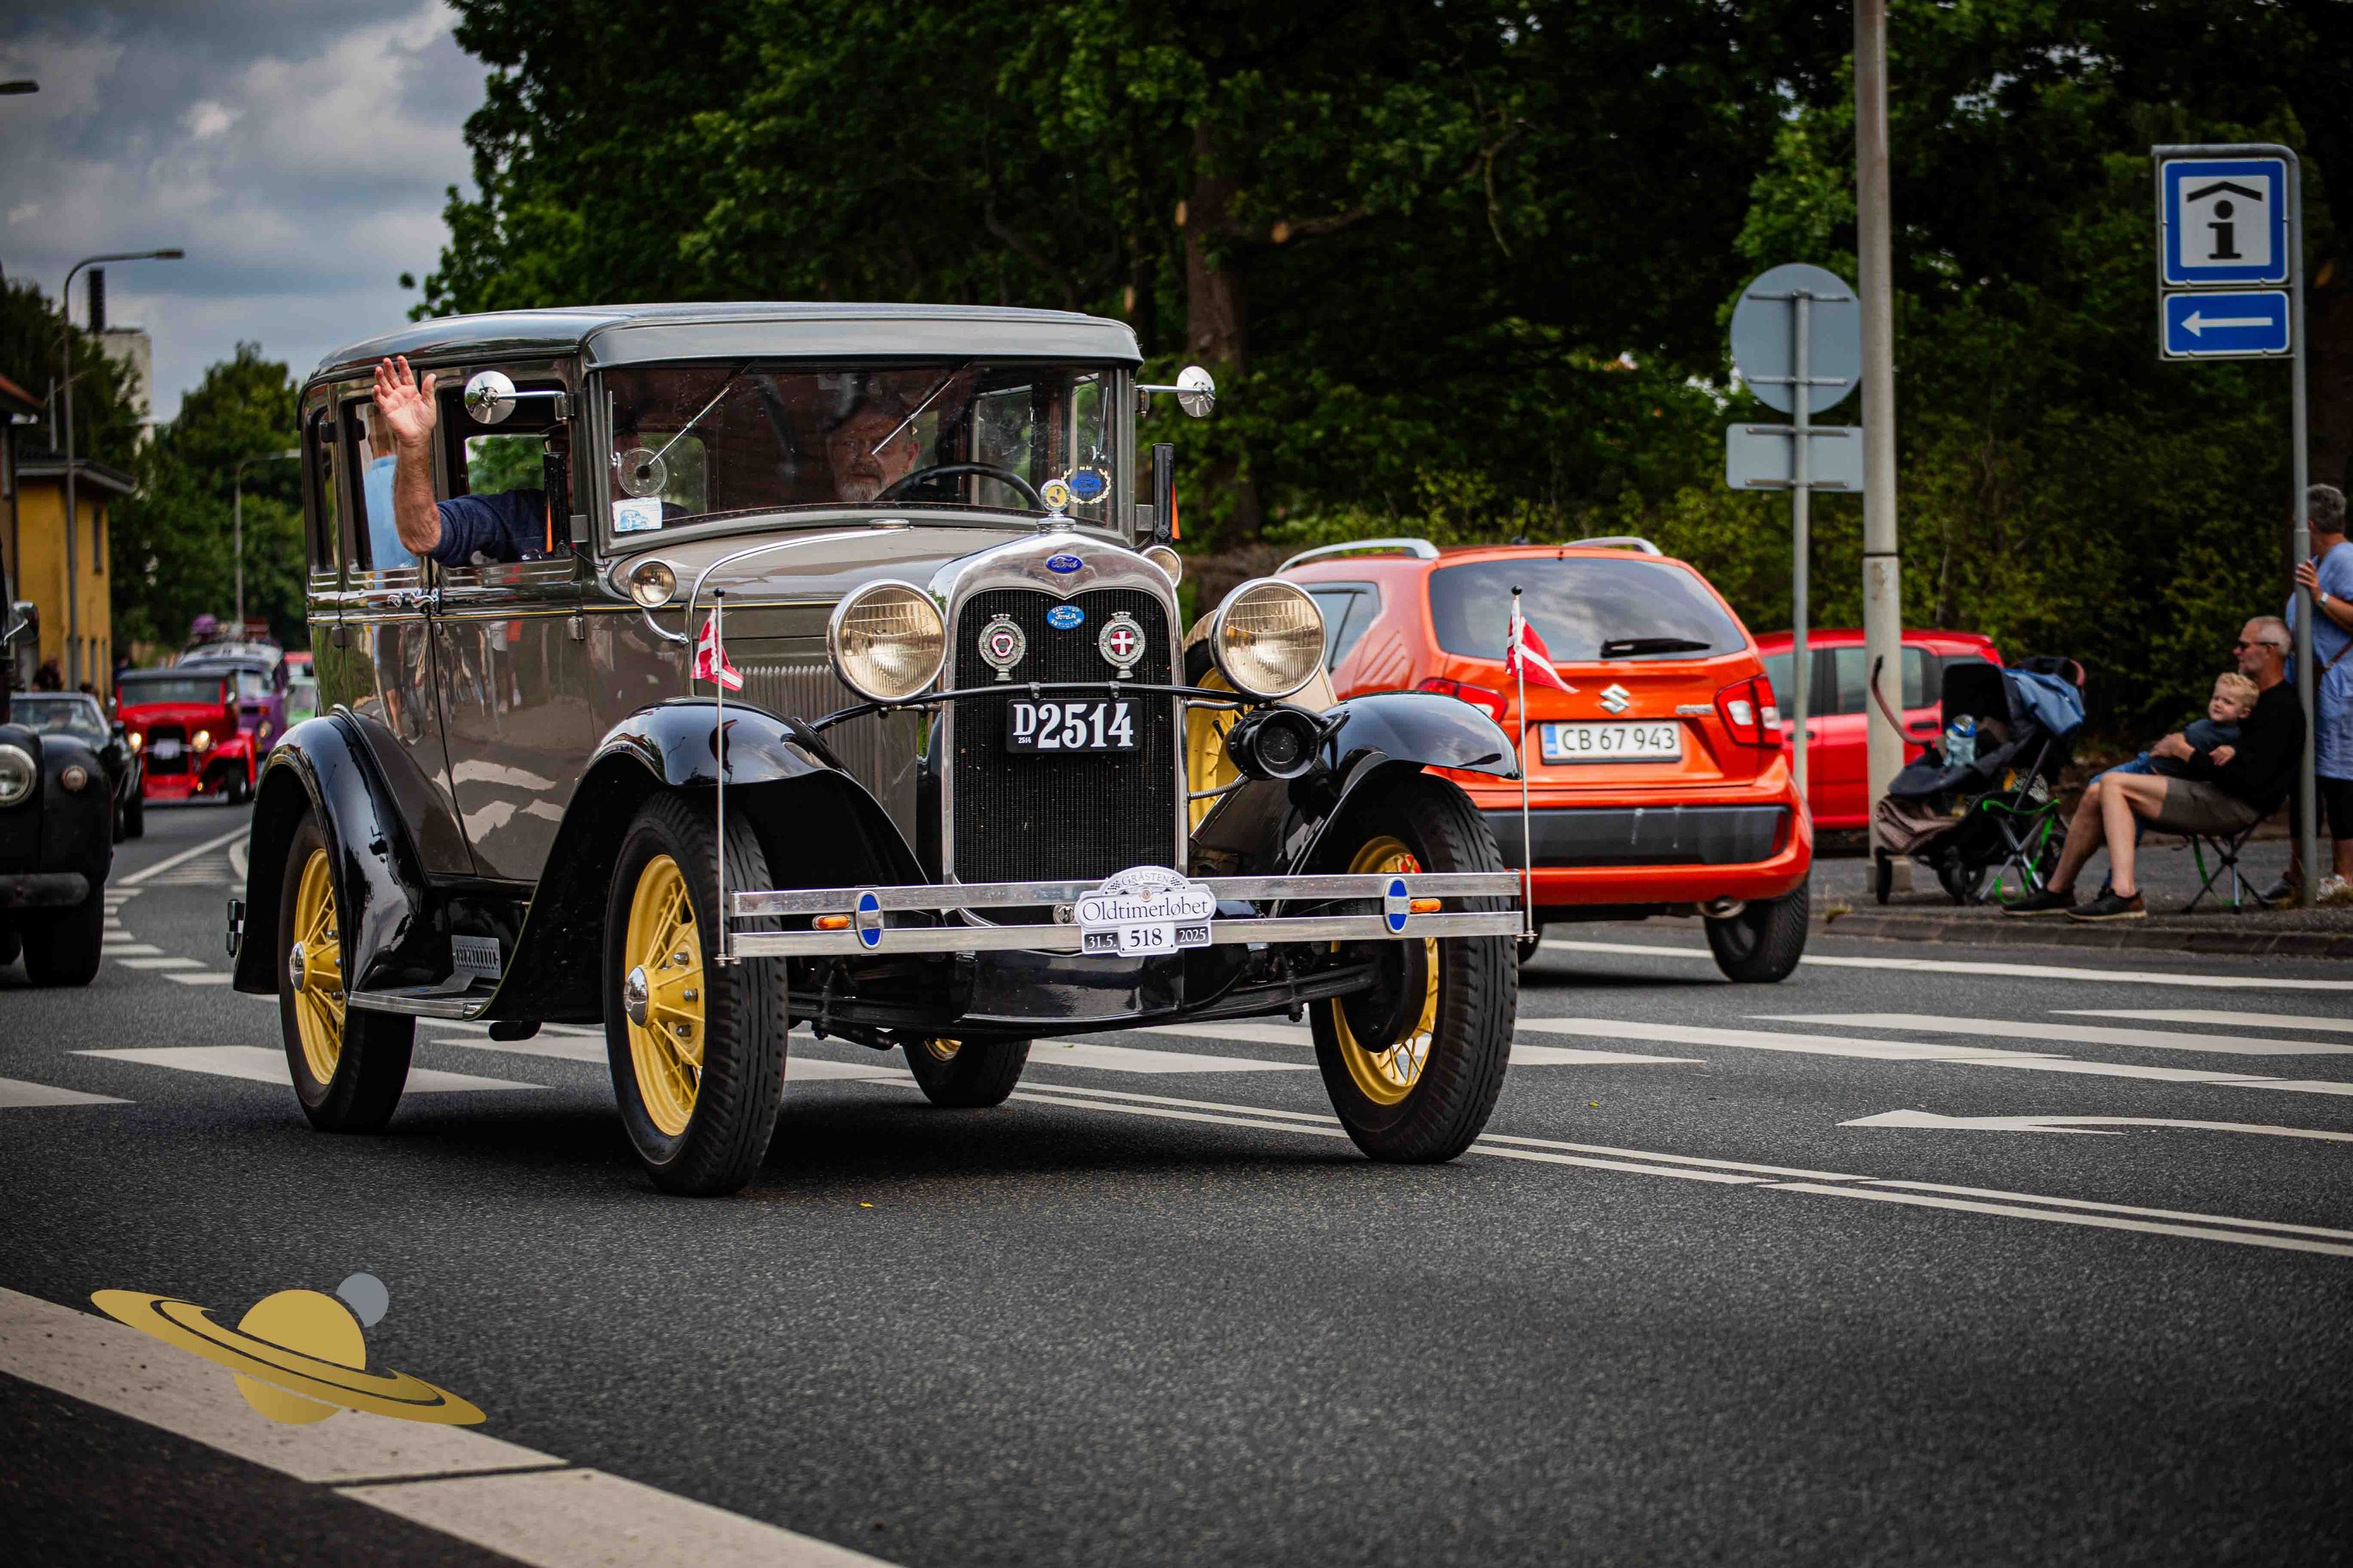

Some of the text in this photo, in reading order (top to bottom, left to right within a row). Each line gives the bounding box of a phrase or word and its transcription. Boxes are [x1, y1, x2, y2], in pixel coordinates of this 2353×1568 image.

[1013, 703, 1134, 748] D2514
[1562, 728, 1674, 751] CB 67 943
[1121, 872, 1169, 886] GRÅSTEN
[1082, 896, 1208, 921] Oldtimerløbet
[1088, 928, 1207, 949] 31.5. 518 2025
